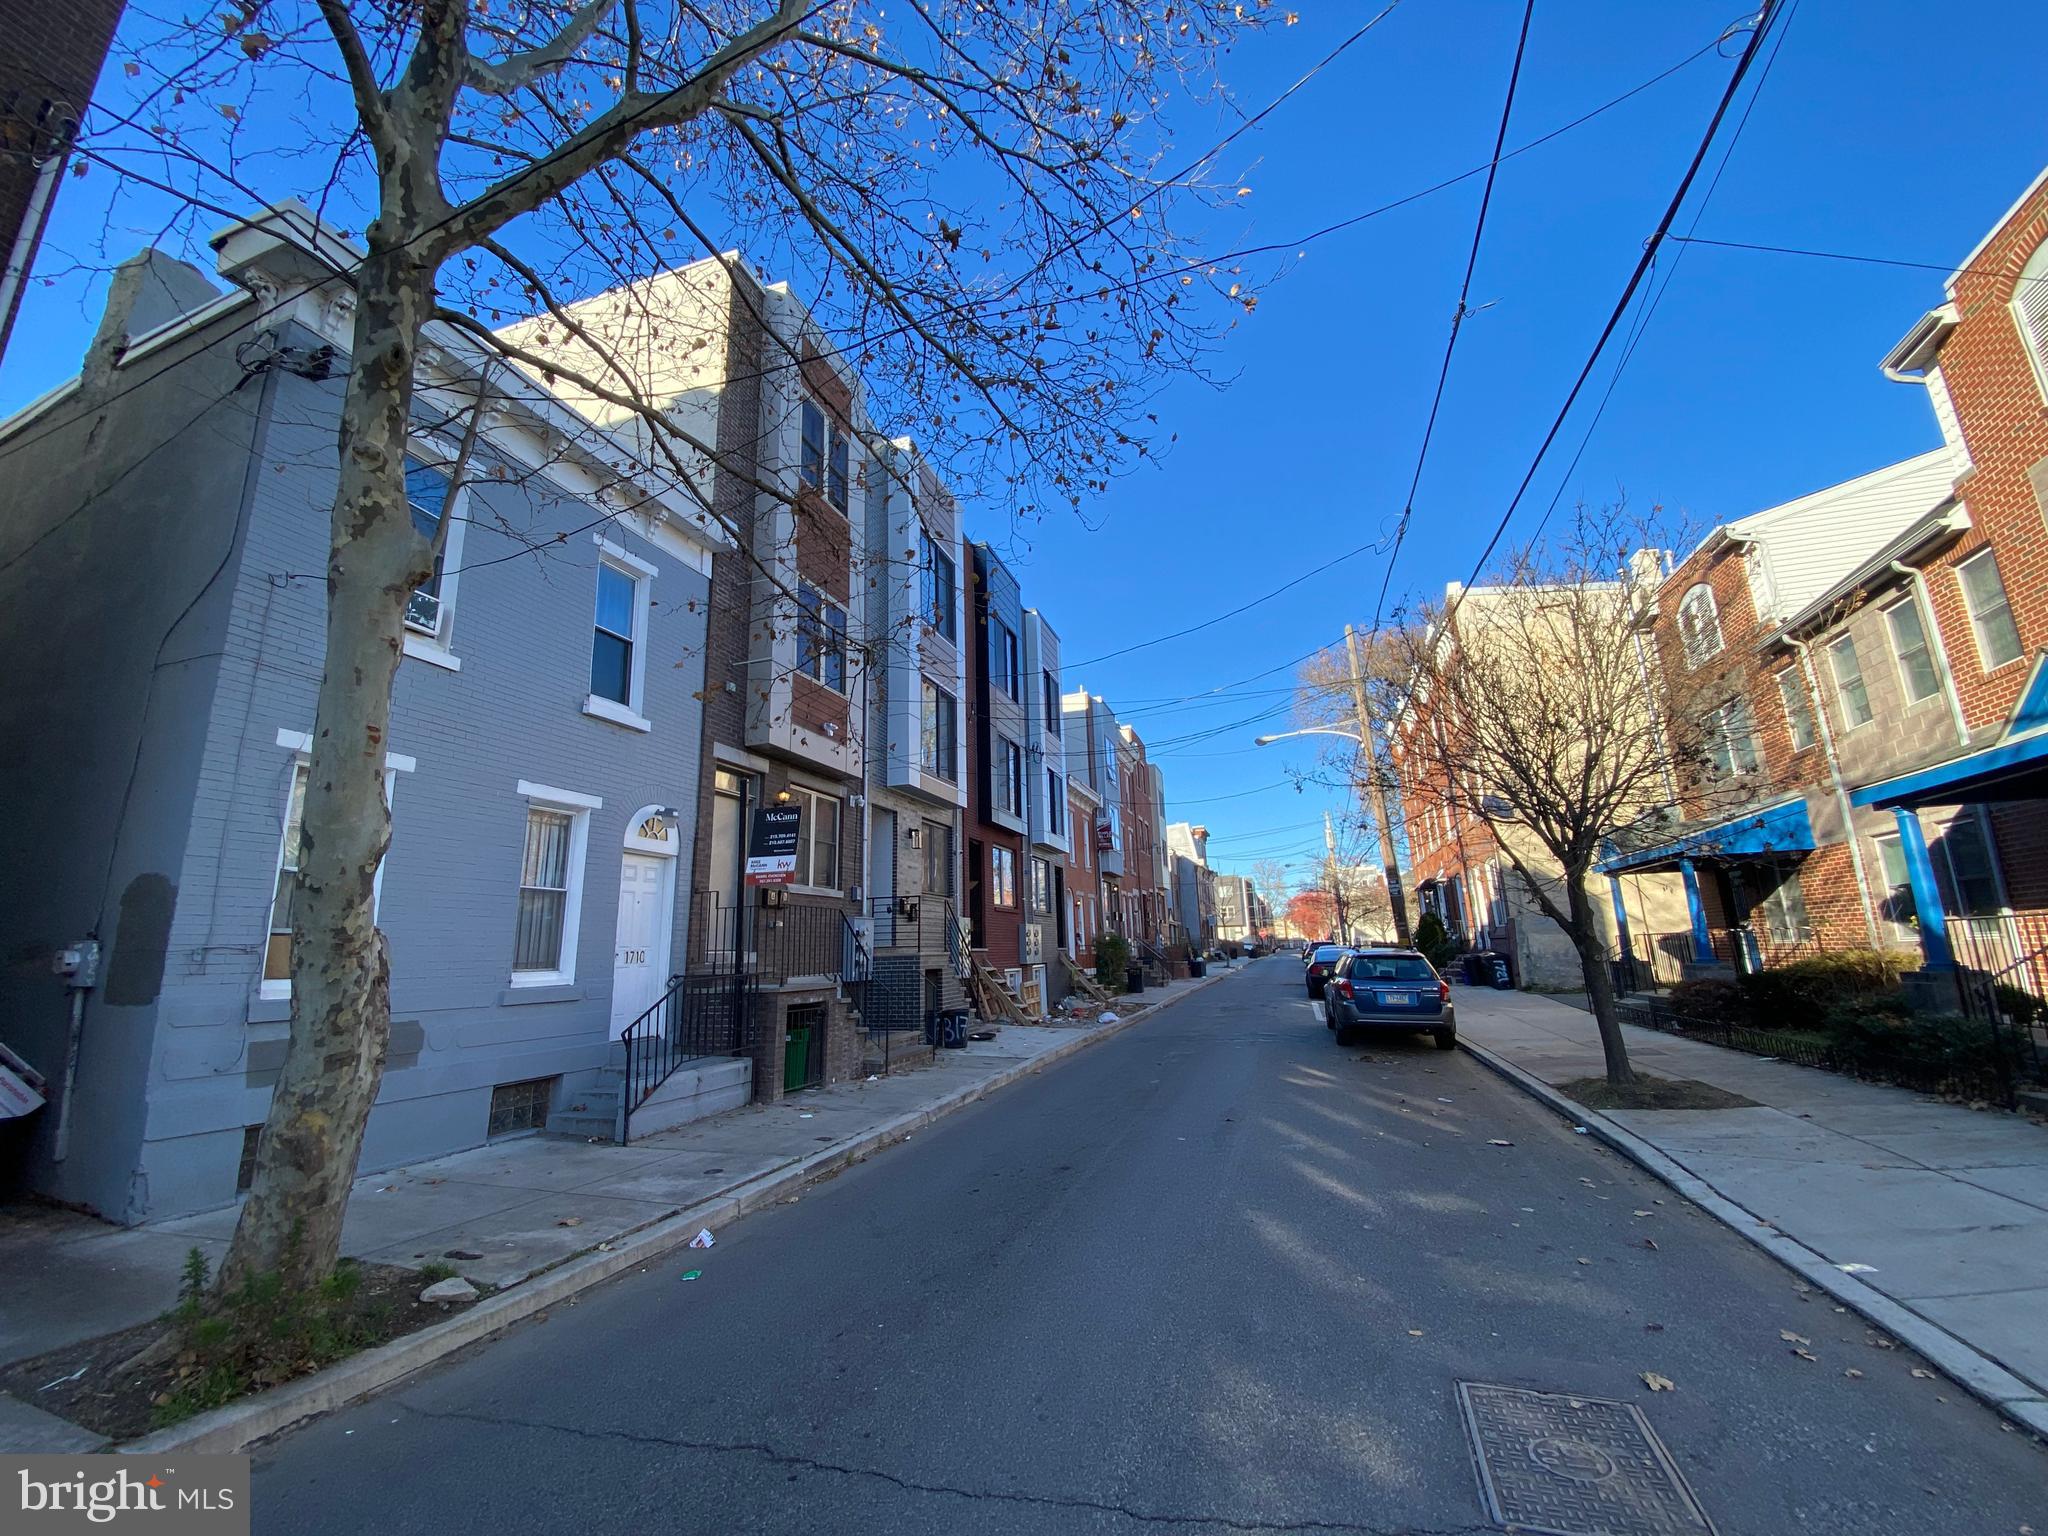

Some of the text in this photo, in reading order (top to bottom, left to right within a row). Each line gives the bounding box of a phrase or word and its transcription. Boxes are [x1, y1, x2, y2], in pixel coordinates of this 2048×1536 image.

[766, 813, 798, 821] McCann
[777, 859, 791, 869] kw
[625, 950, 645, 964] 1710
